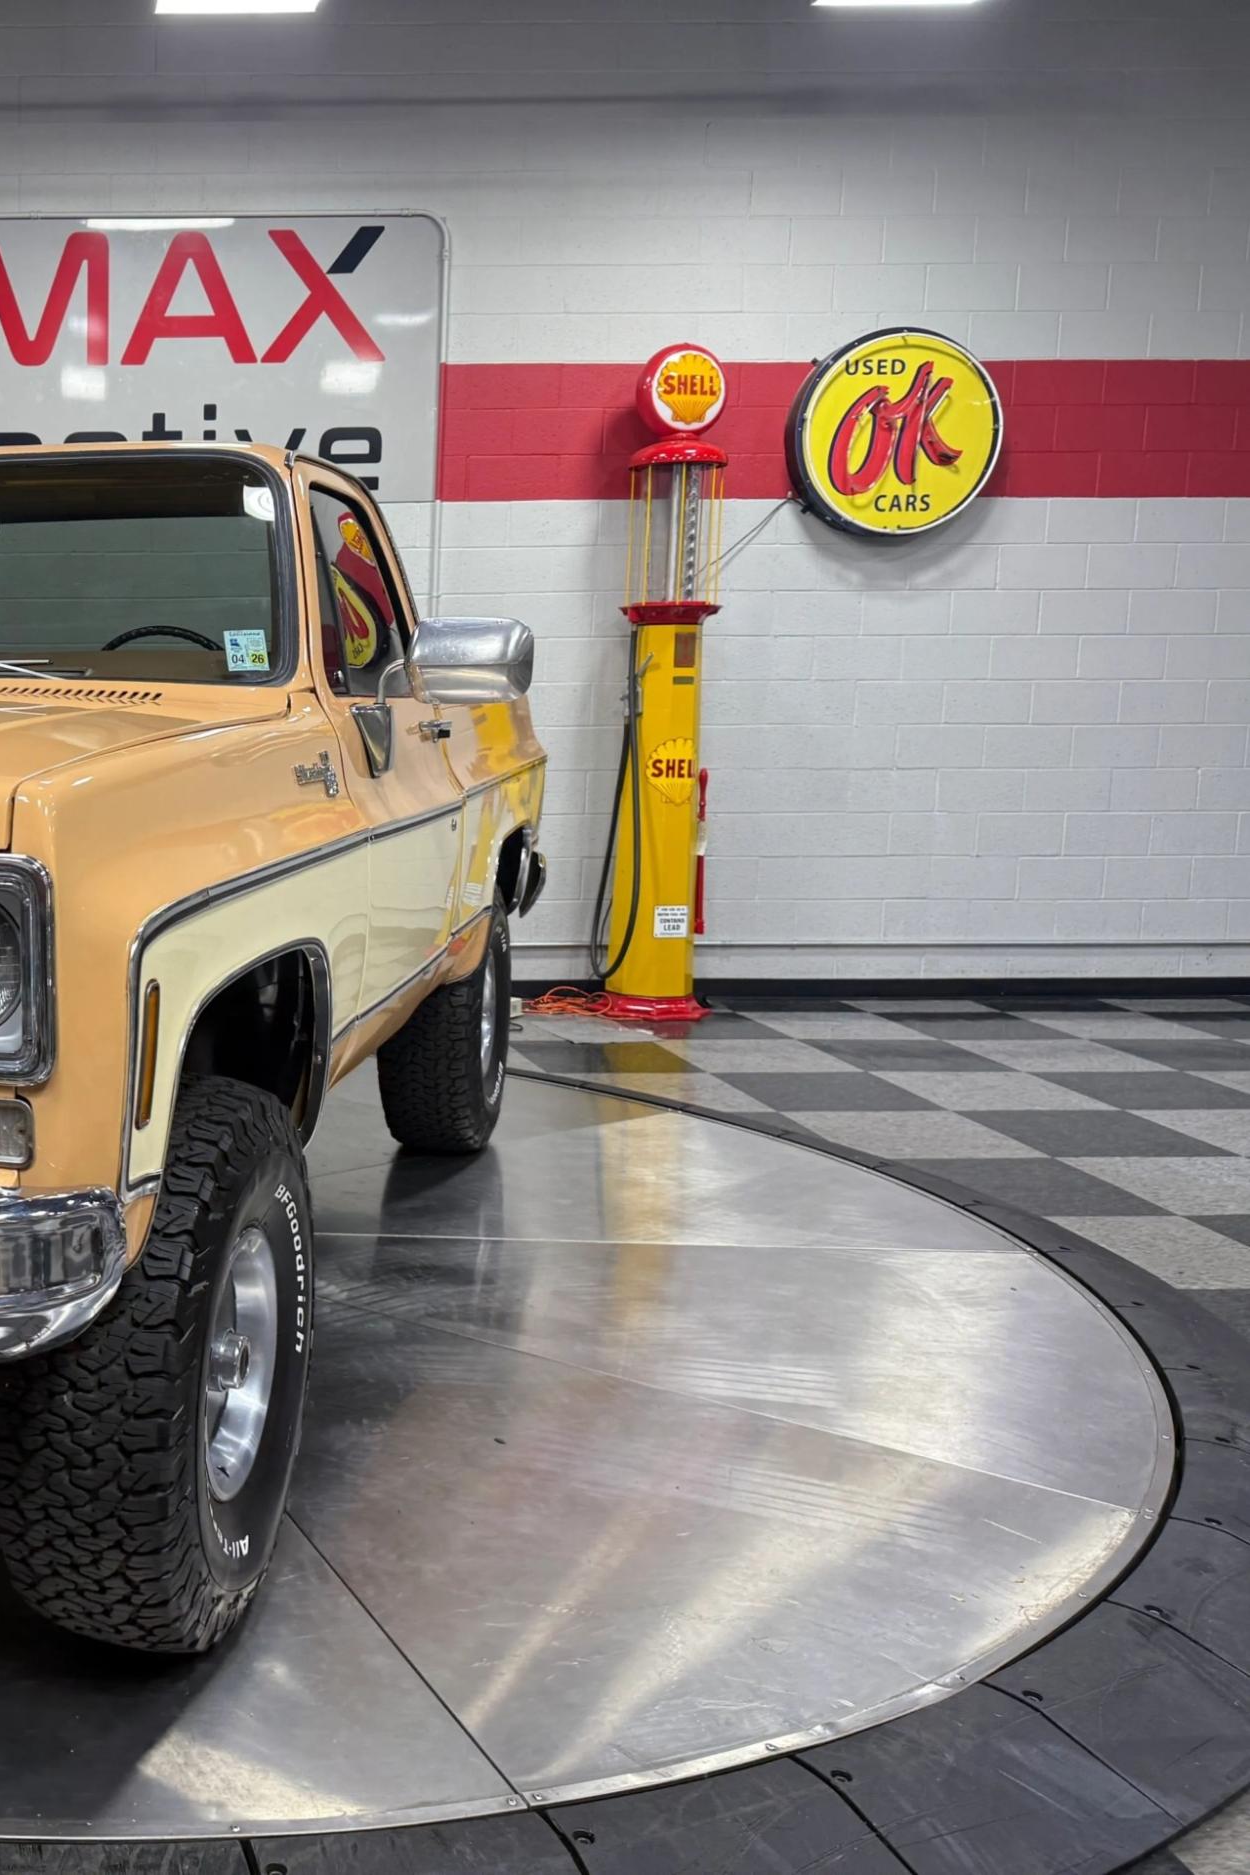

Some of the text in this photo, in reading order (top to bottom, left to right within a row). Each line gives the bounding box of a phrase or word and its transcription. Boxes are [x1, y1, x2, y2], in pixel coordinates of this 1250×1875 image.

[845, 359, 906, 376] USED
[663, 374, 717, 396] SHELL
[828, 361, 963, 496] OK
[874, 494, 931, 512] CARS
[231, 654, 245, 664] 04
[251, 654, 265, 664] 26
[651, 759, 693, 778] SHEL
[274, 1184, 306, 1353] BFGoodrich
